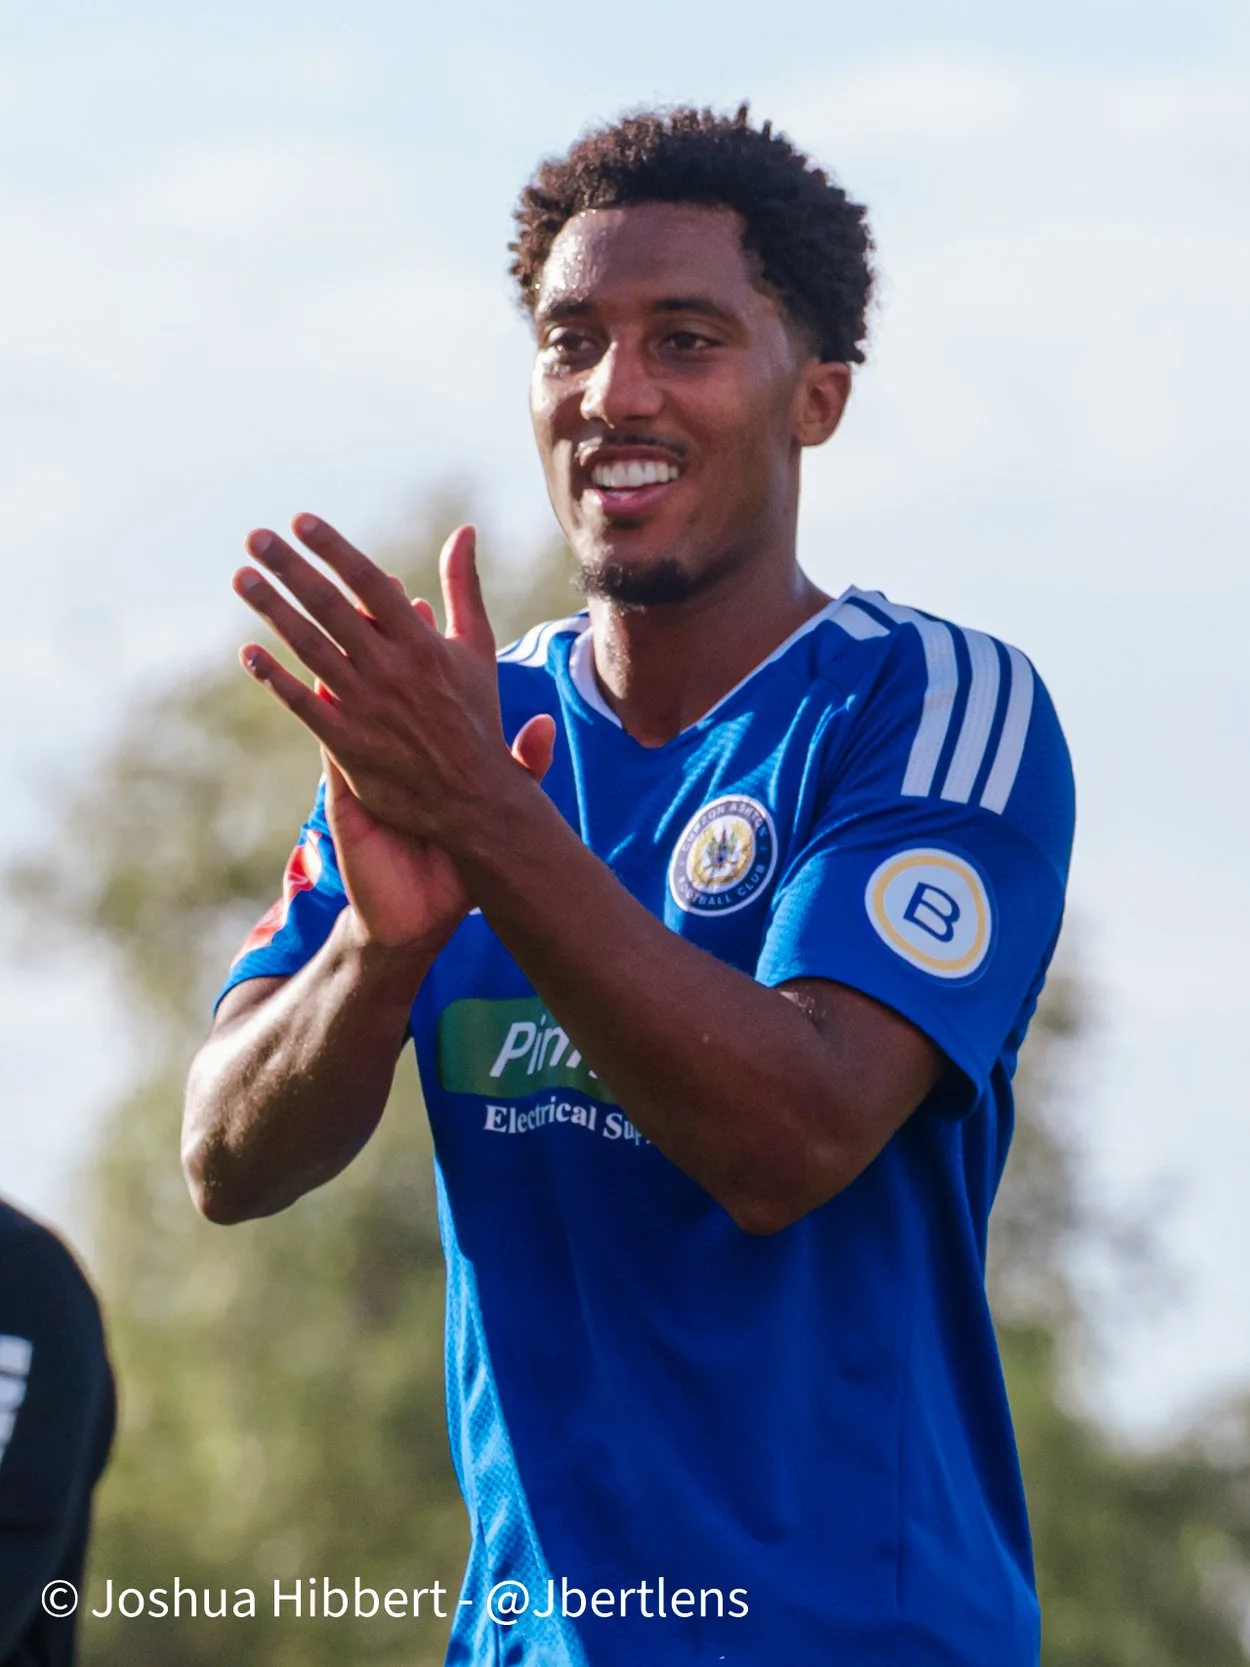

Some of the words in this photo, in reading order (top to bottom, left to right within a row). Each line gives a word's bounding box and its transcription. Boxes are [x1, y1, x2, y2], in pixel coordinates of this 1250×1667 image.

[737, 863, 766, 896] CLUB
[902, 881, 961, 943] B
[484, 1096, 597, 1134] Electrical
